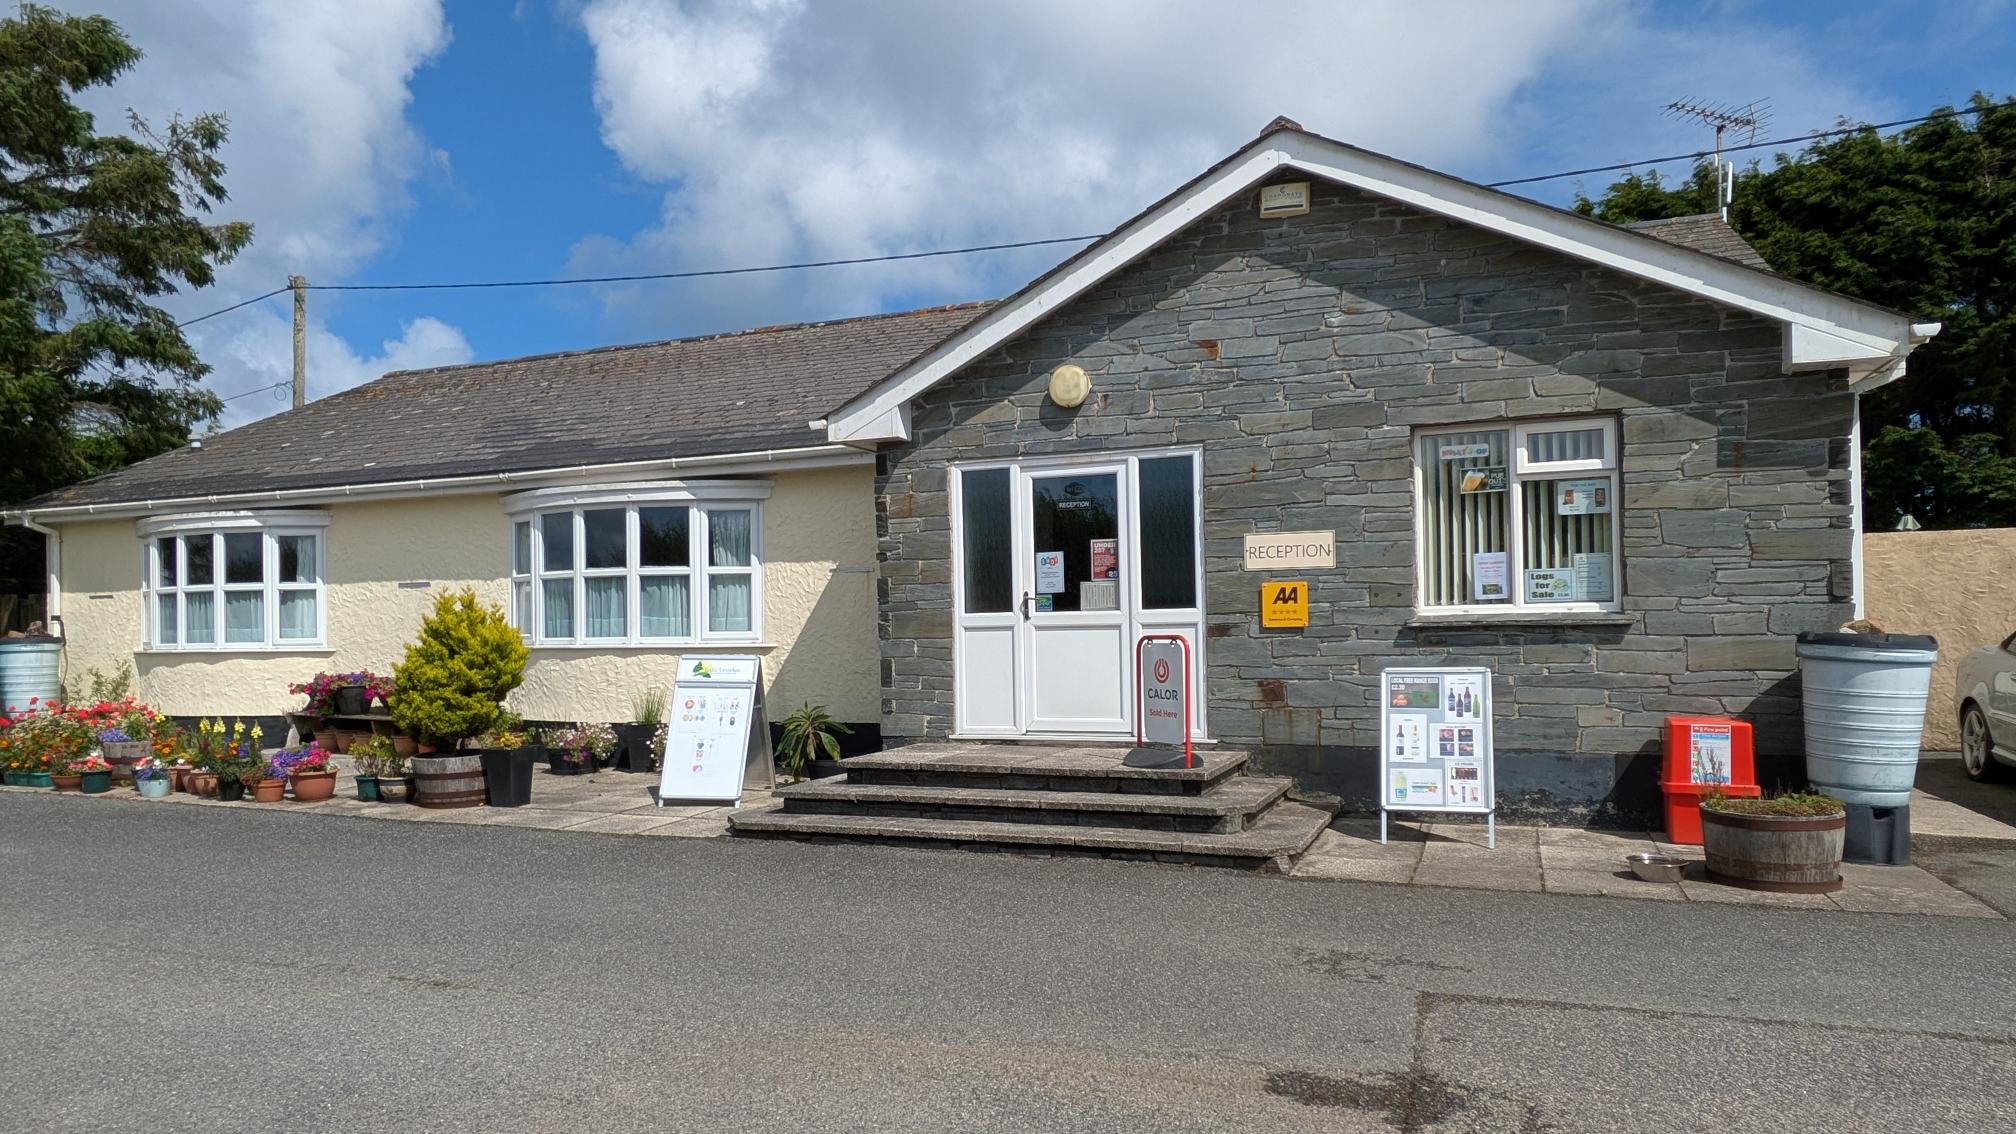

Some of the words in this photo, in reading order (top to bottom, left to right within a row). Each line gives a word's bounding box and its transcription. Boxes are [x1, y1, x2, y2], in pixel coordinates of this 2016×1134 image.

[1248, 544, 1331, 559] RECEPTION
[1530, 573, 1555, 581] Logs
[1272, 586, 1298, 605] AA
[1531, 591, 1555, 599] Sale
[1147, 688, 1179, 701] CALOR
[1149, 708, 1163, 718] Sold
[1163, 709, 1178, 719] Here
